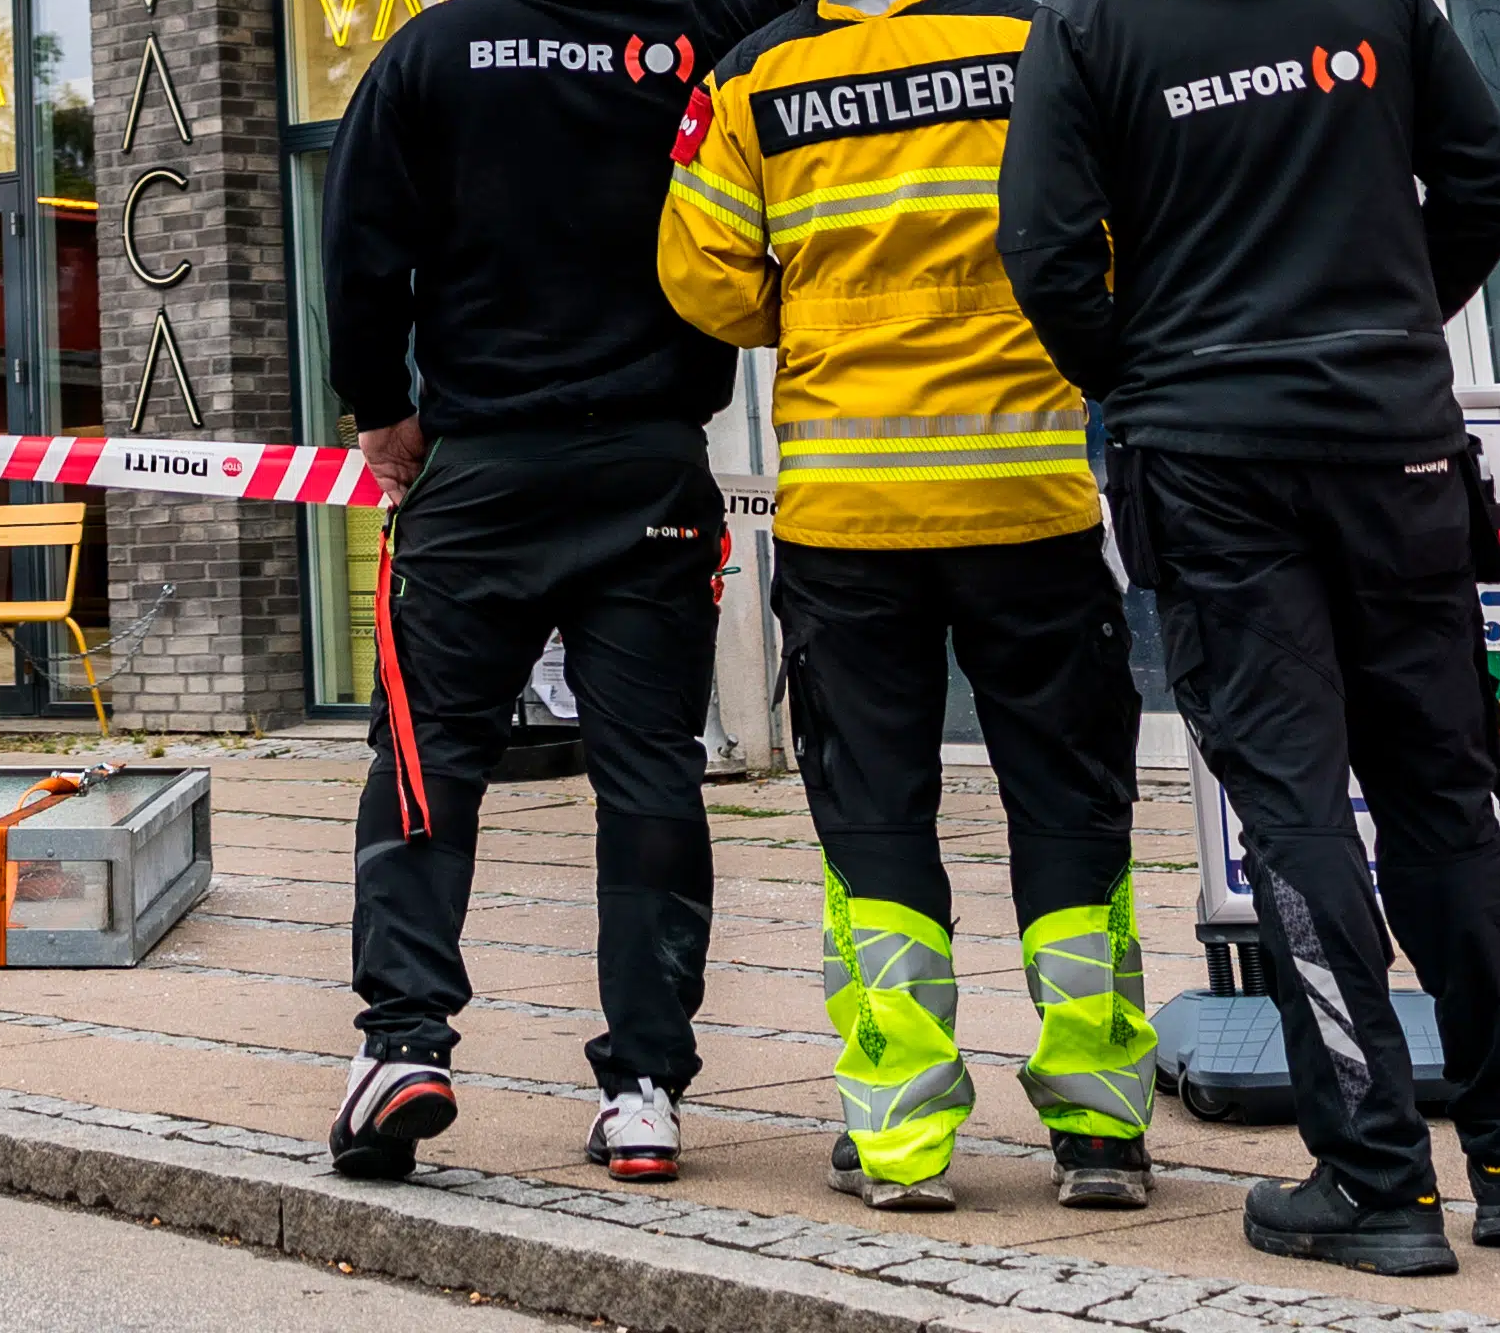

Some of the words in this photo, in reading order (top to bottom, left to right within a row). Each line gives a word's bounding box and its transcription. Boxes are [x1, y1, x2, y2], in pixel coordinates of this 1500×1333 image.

[469, 38, 614, 71] BELFOR
[773, 63, 1015, 137] VAGTLEDER
[1163, 59, 1306, 119] BELFOR
[125, 452, 208, 477] POLITI
